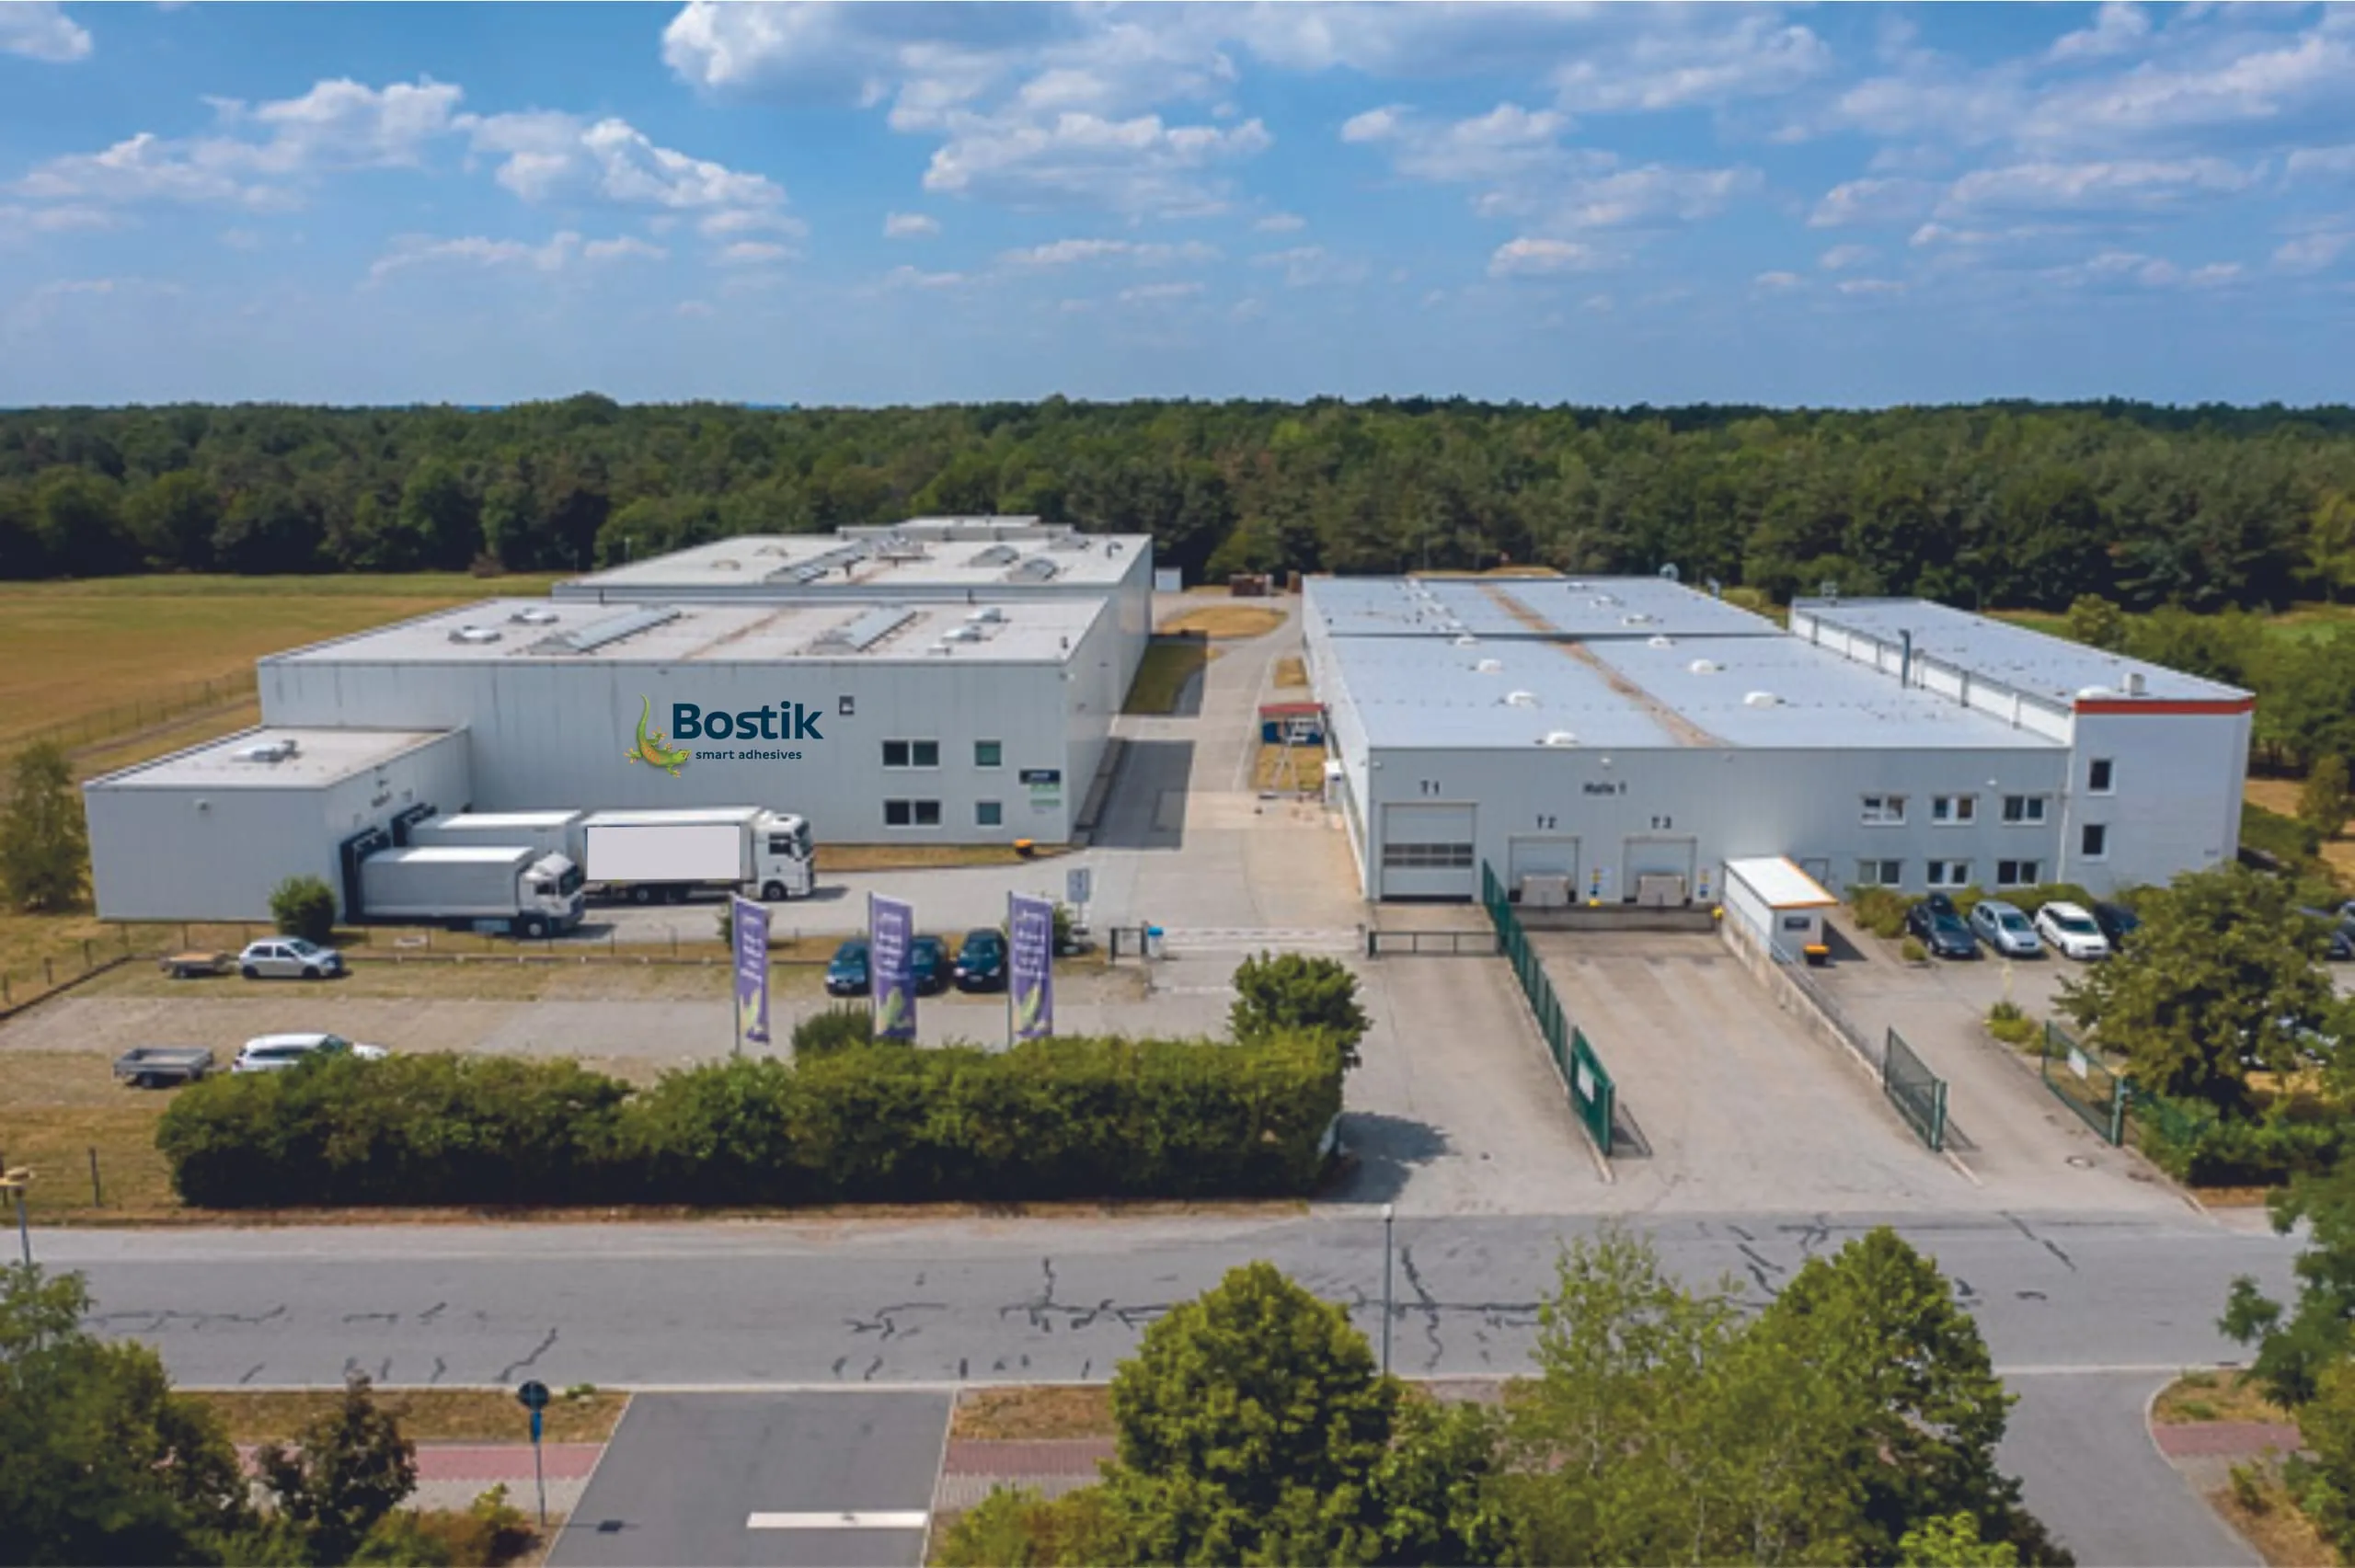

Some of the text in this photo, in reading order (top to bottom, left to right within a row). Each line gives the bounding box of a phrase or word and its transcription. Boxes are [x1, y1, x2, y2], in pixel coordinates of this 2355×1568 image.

[672, 700, 824, 739] Bostik
[695, 749, 802, 760] smart adhesives
[1419, 780, 1430, 795] T
